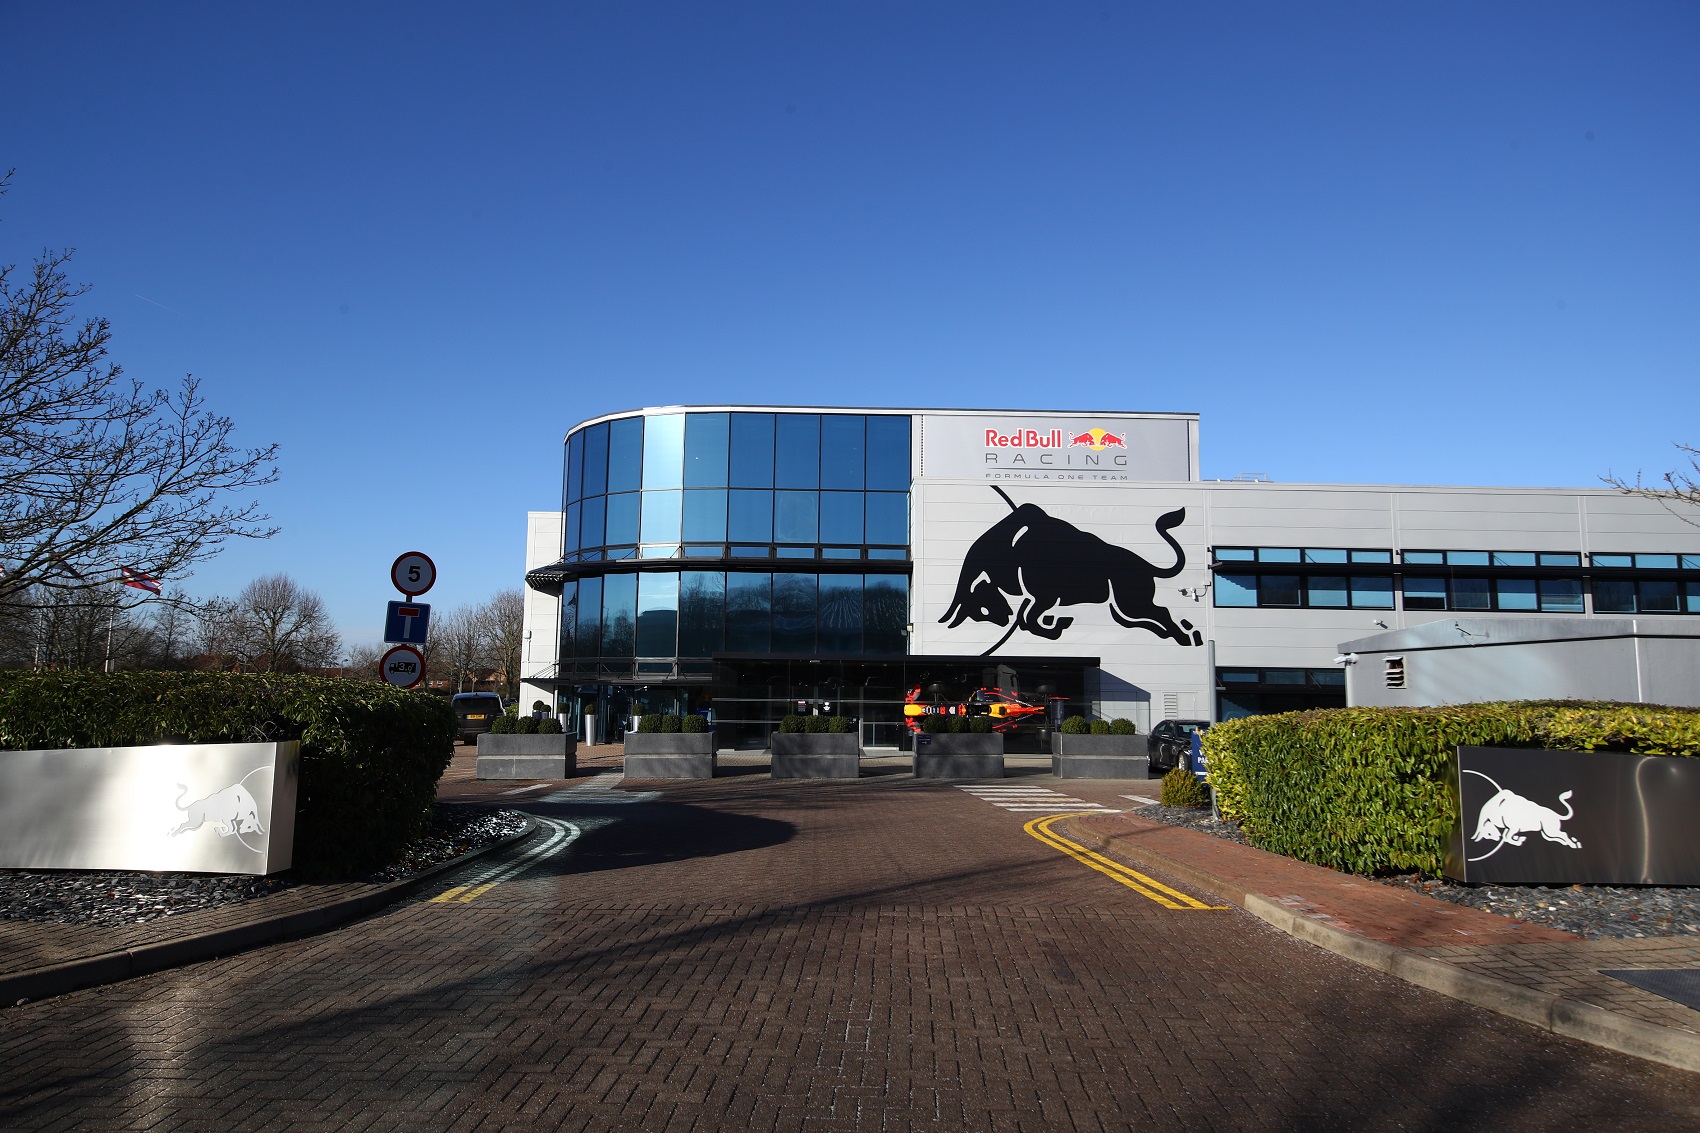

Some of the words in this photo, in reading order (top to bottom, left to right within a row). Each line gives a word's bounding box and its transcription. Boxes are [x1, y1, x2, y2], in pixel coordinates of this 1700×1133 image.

[985, 429, 1022, 448] Red
[1025, 430, 1061, 448] Bull
[985, 453, 1127, 466] RACING
[408, 565, 421, 583] 5
